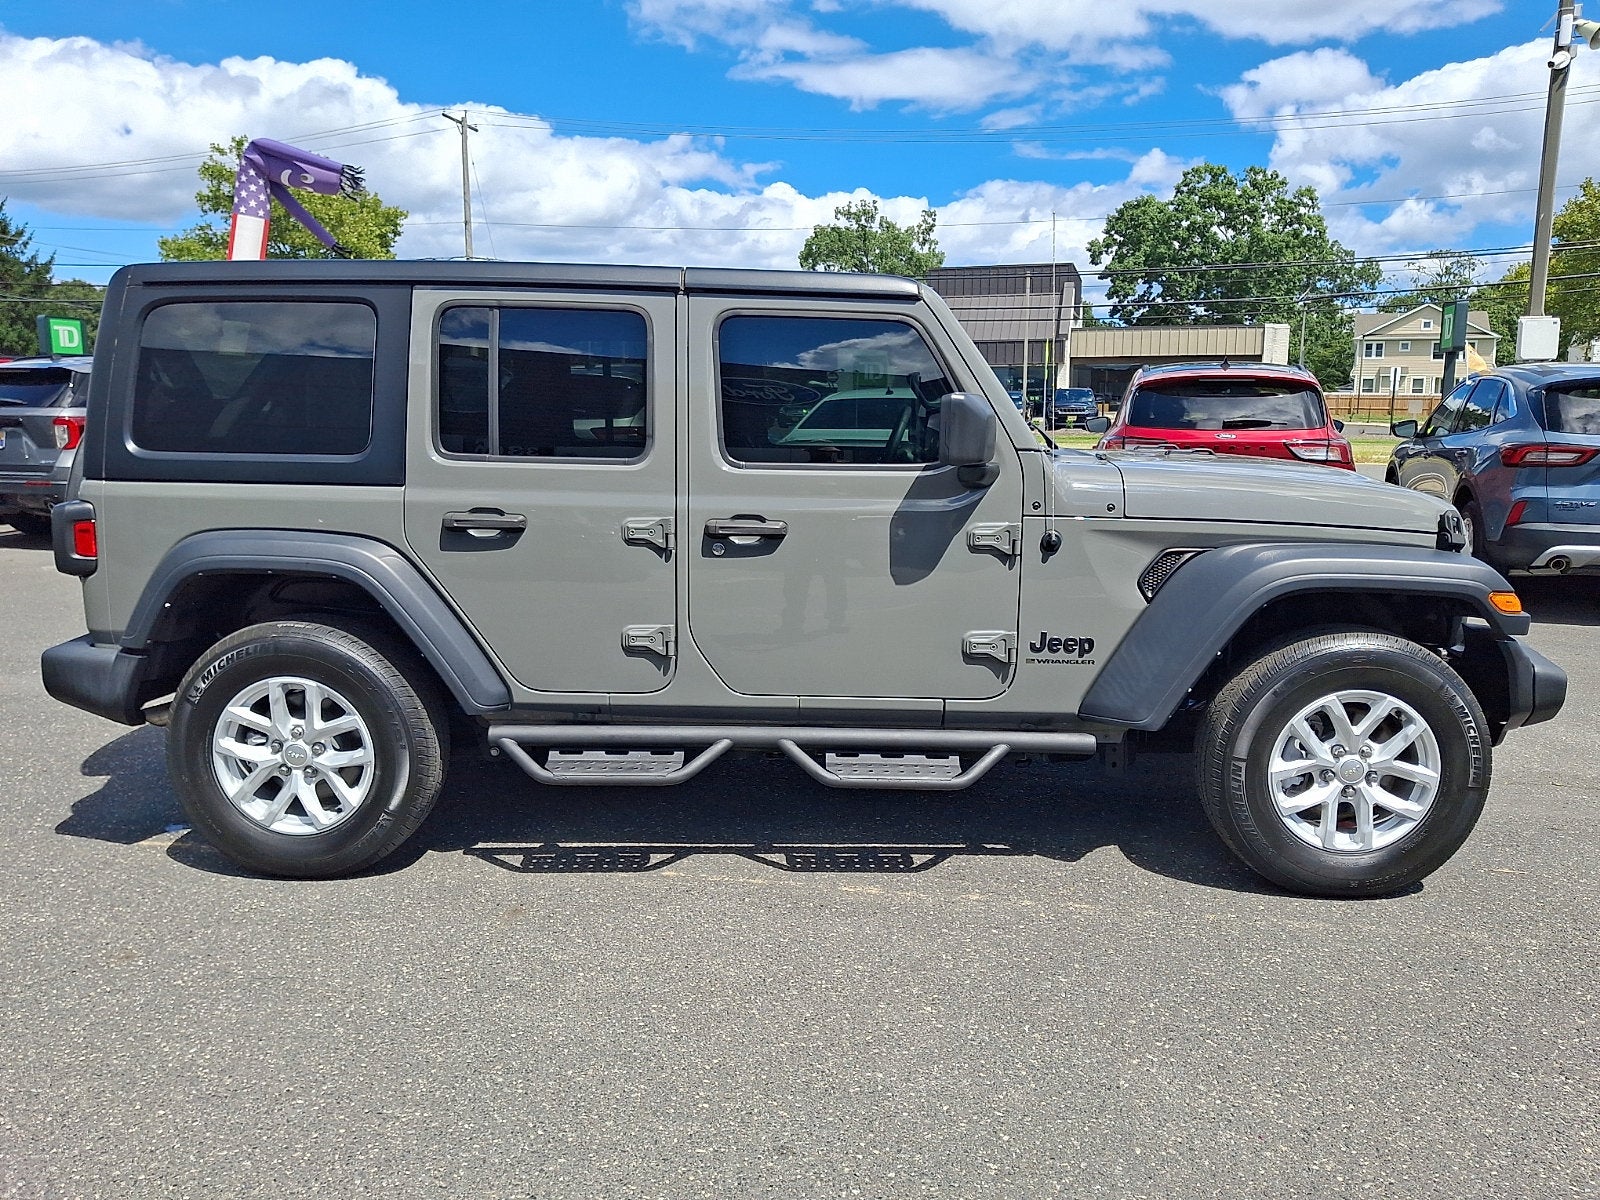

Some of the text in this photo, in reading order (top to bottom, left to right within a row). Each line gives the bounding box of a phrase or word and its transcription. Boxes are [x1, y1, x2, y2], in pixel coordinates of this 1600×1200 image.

[53, 325, 79, 347] TD
[1444, 314, 1454, 339] TD
[1029, 631, 1095, 658] Jeep
[1455, 704, 1482, 784] MICHELIN
